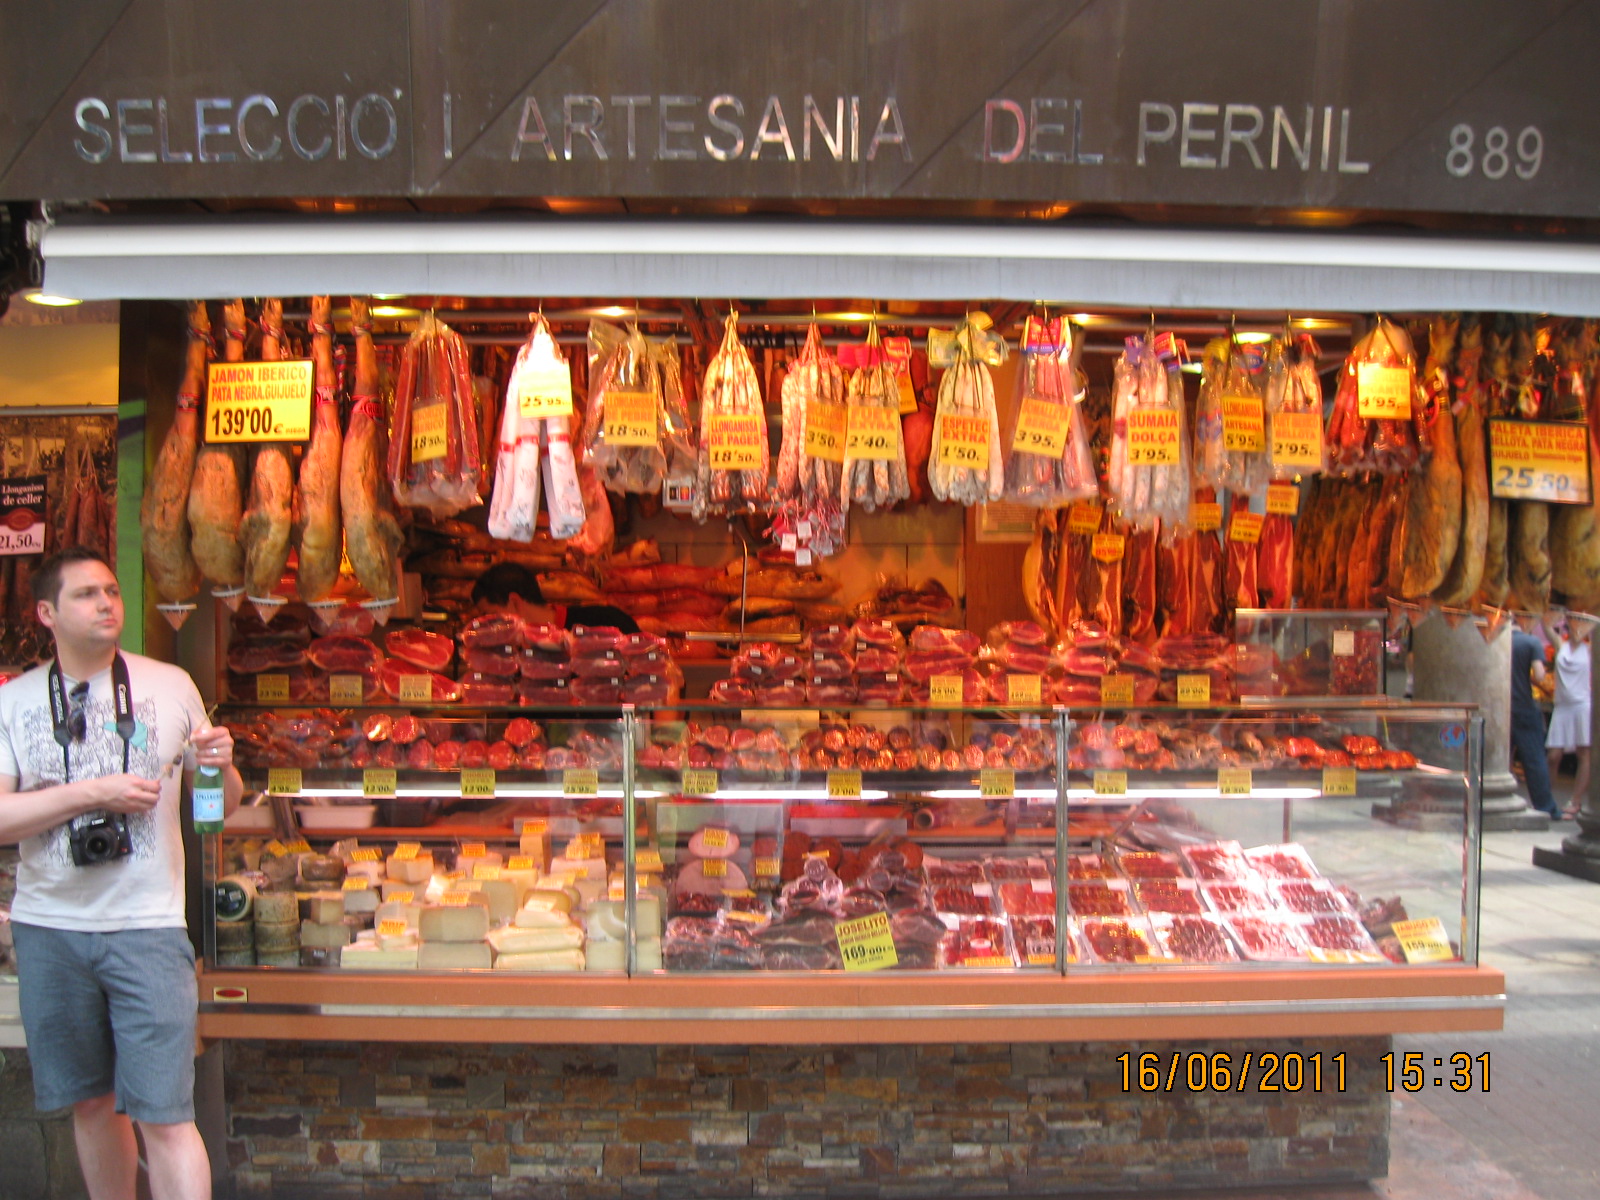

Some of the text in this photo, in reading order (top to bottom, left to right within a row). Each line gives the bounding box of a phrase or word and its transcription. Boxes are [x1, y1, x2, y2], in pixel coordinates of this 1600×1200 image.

[443, 93, 452, 160] I
[511, 94, 913, 163] ARTESANIA
[984, 98, 1103, 165] DEL
[1137, 103, 1370, 174] PERNIL
[1446, 122, 1544, 181] 889
[212, 366, 307, 384] JAMON IBERICO
[212, 386, 232, 403] PATA
[711, 419, 758, 433] LLONGANISSA
[1130, 412, 1178, 428] SUMAIA
[711, 434, 724, 446] DE
[943, 430, 987, 443] EXTRA
[1131, 431, 1177, 446] DOLÇA
[1532, 437, 1553, 450] PATA
[1555, 439, 1585, 451] NEGRA
[2, 484, 44, 495] Llonganissa
[3, 493, 42, 506] de celler
[838, 916, 887, 937] JOSELITO
